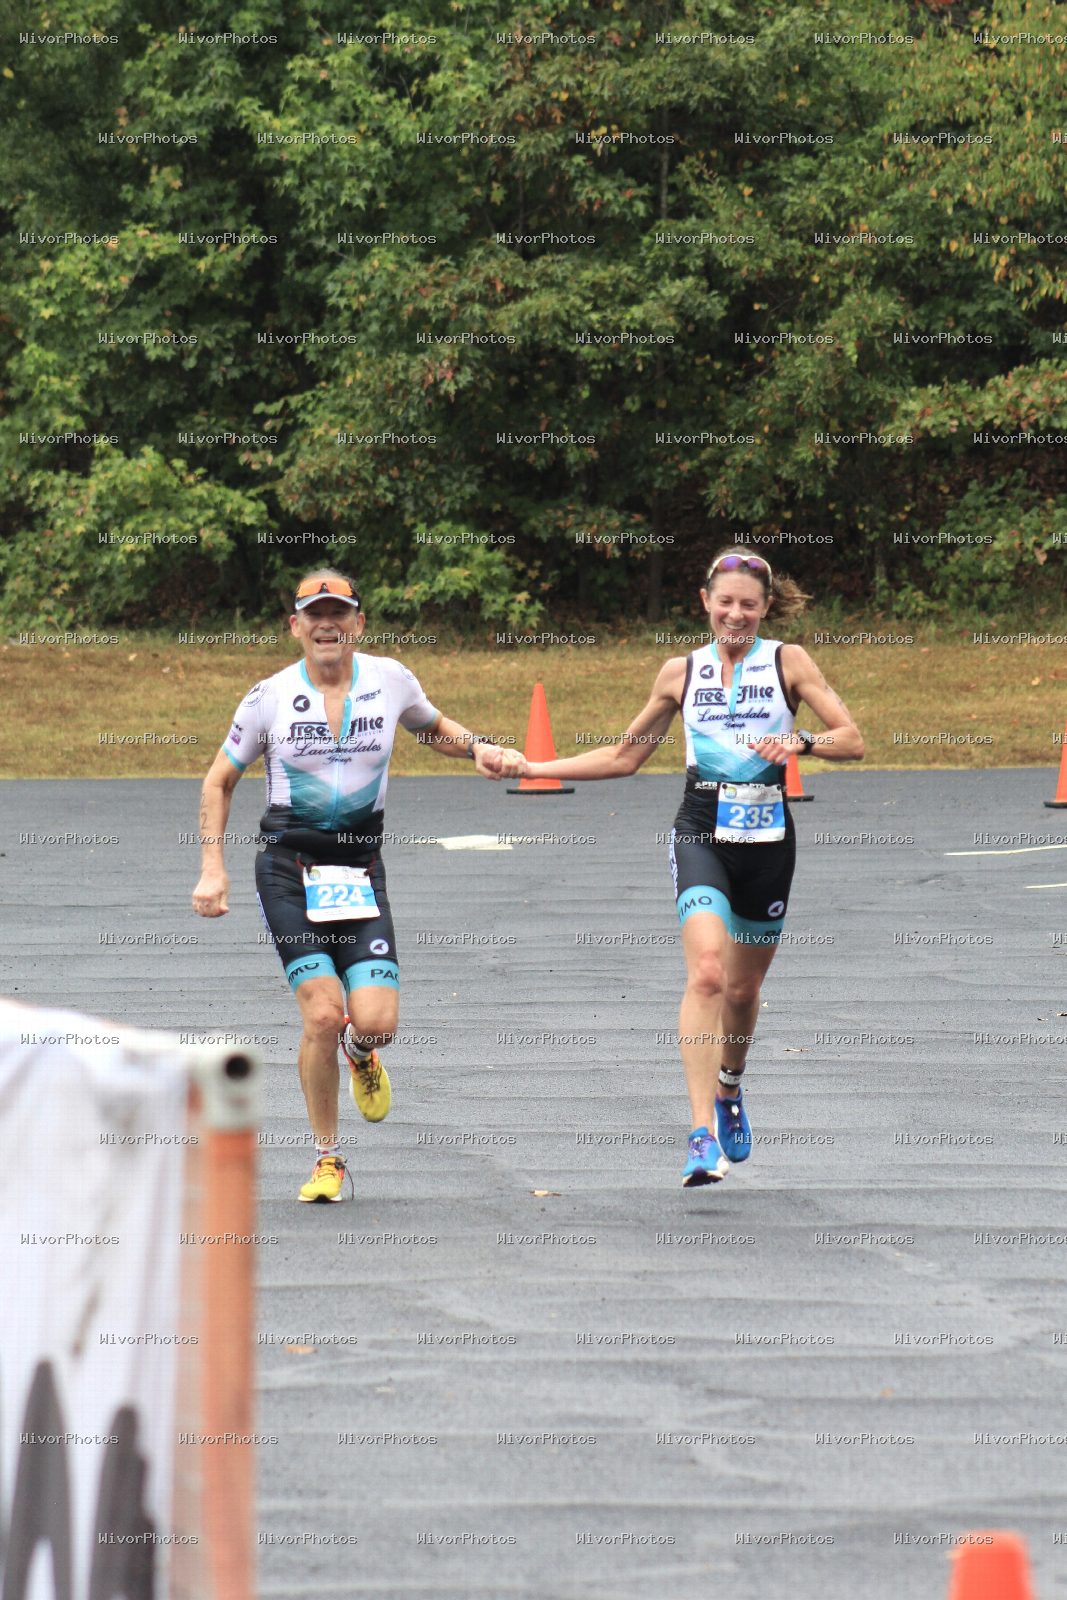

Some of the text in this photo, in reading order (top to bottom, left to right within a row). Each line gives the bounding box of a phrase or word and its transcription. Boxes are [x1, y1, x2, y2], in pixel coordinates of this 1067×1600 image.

[728, 805, 774, 828] 235
[317, 885, 366, 908] 224
[679, 895, 712, 921] IMO
